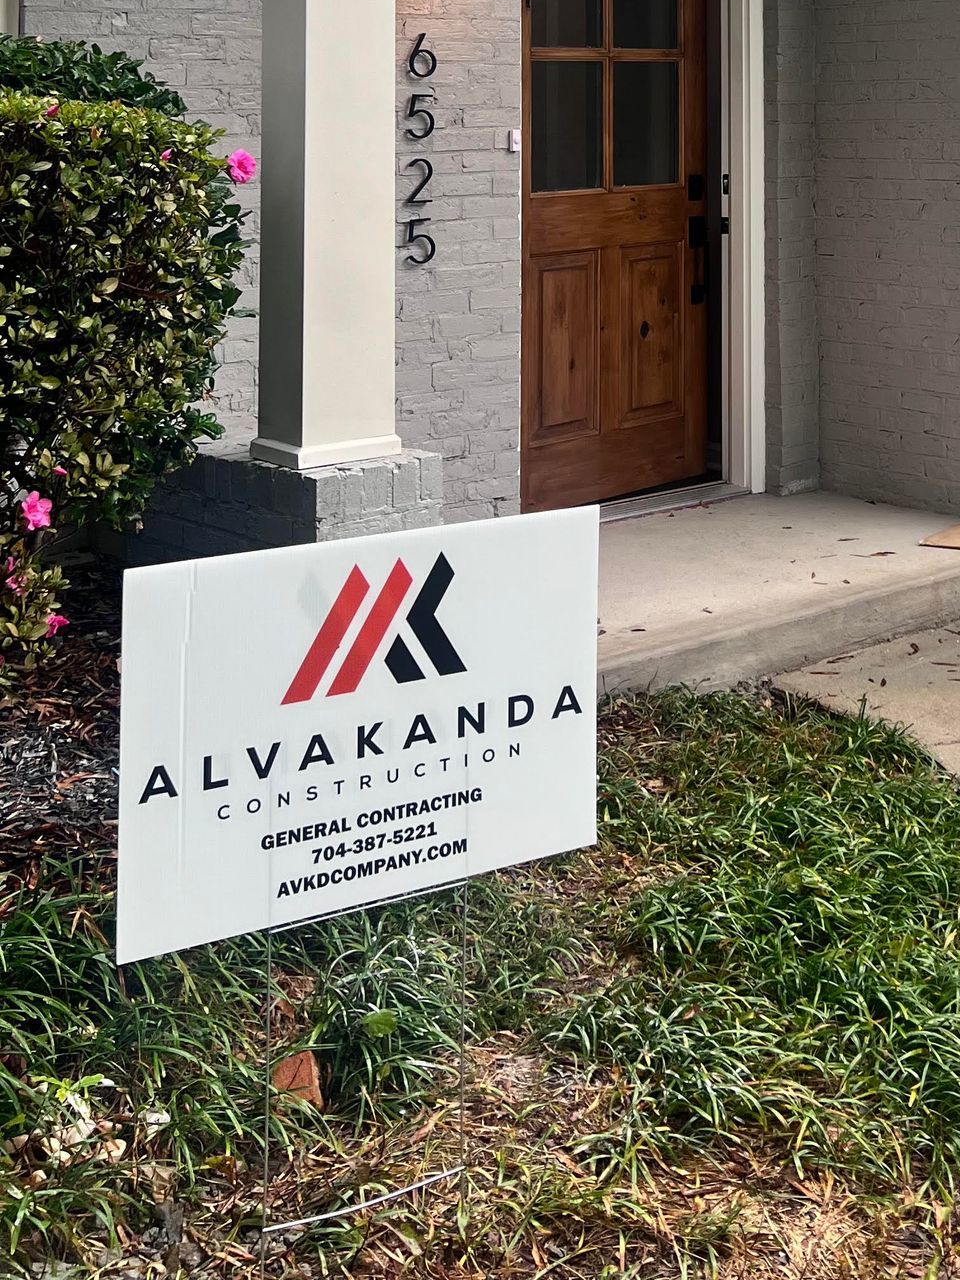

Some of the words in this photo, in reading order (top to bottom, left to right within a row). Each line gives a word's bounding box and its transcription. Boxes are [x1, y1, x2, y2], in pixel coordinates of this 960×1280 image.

[406, 32, 437, 264] 6525
[138, 685, 583, 805] ALVAKANDA
[217, 742, 521, 820] CONSTRUCTION
[260, 817, 352, 851] GENERAL
[356, 787, 483, 829] CONTRACTING
[311, 822, 438, 865] 704-387-5221
[276, 838, 468, 898] AVKDCOMPANY.COM
